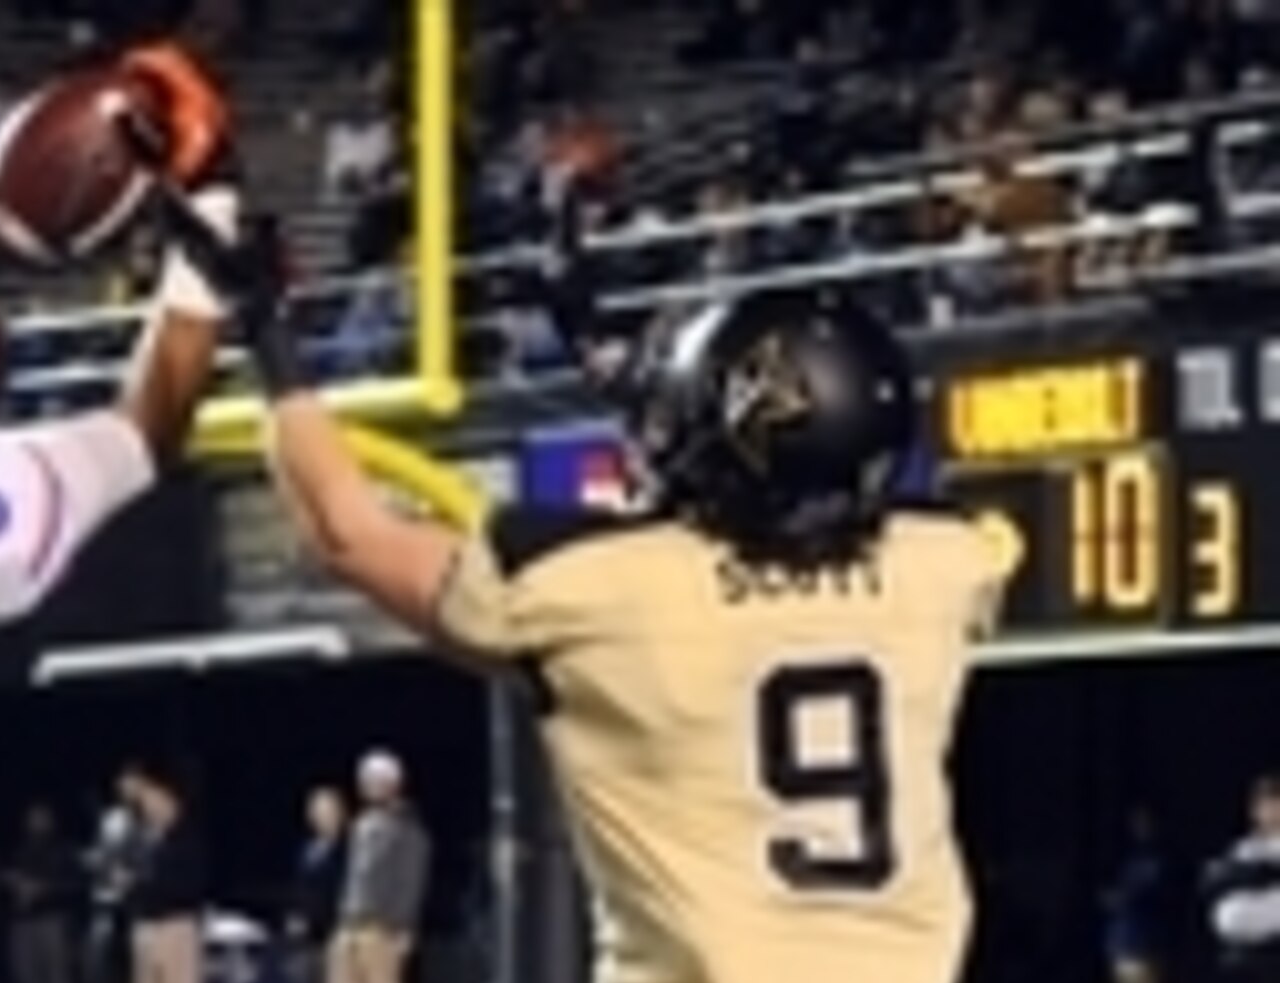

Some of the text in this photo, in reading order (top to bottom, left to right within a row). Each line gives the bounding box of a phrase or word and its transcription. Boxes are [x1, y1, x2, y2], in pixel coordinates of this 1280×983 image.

[1072, 452, 1160, 608] 10
[1188, 478, 1240, 616] 3
[756, 655, 898, 893] 9
